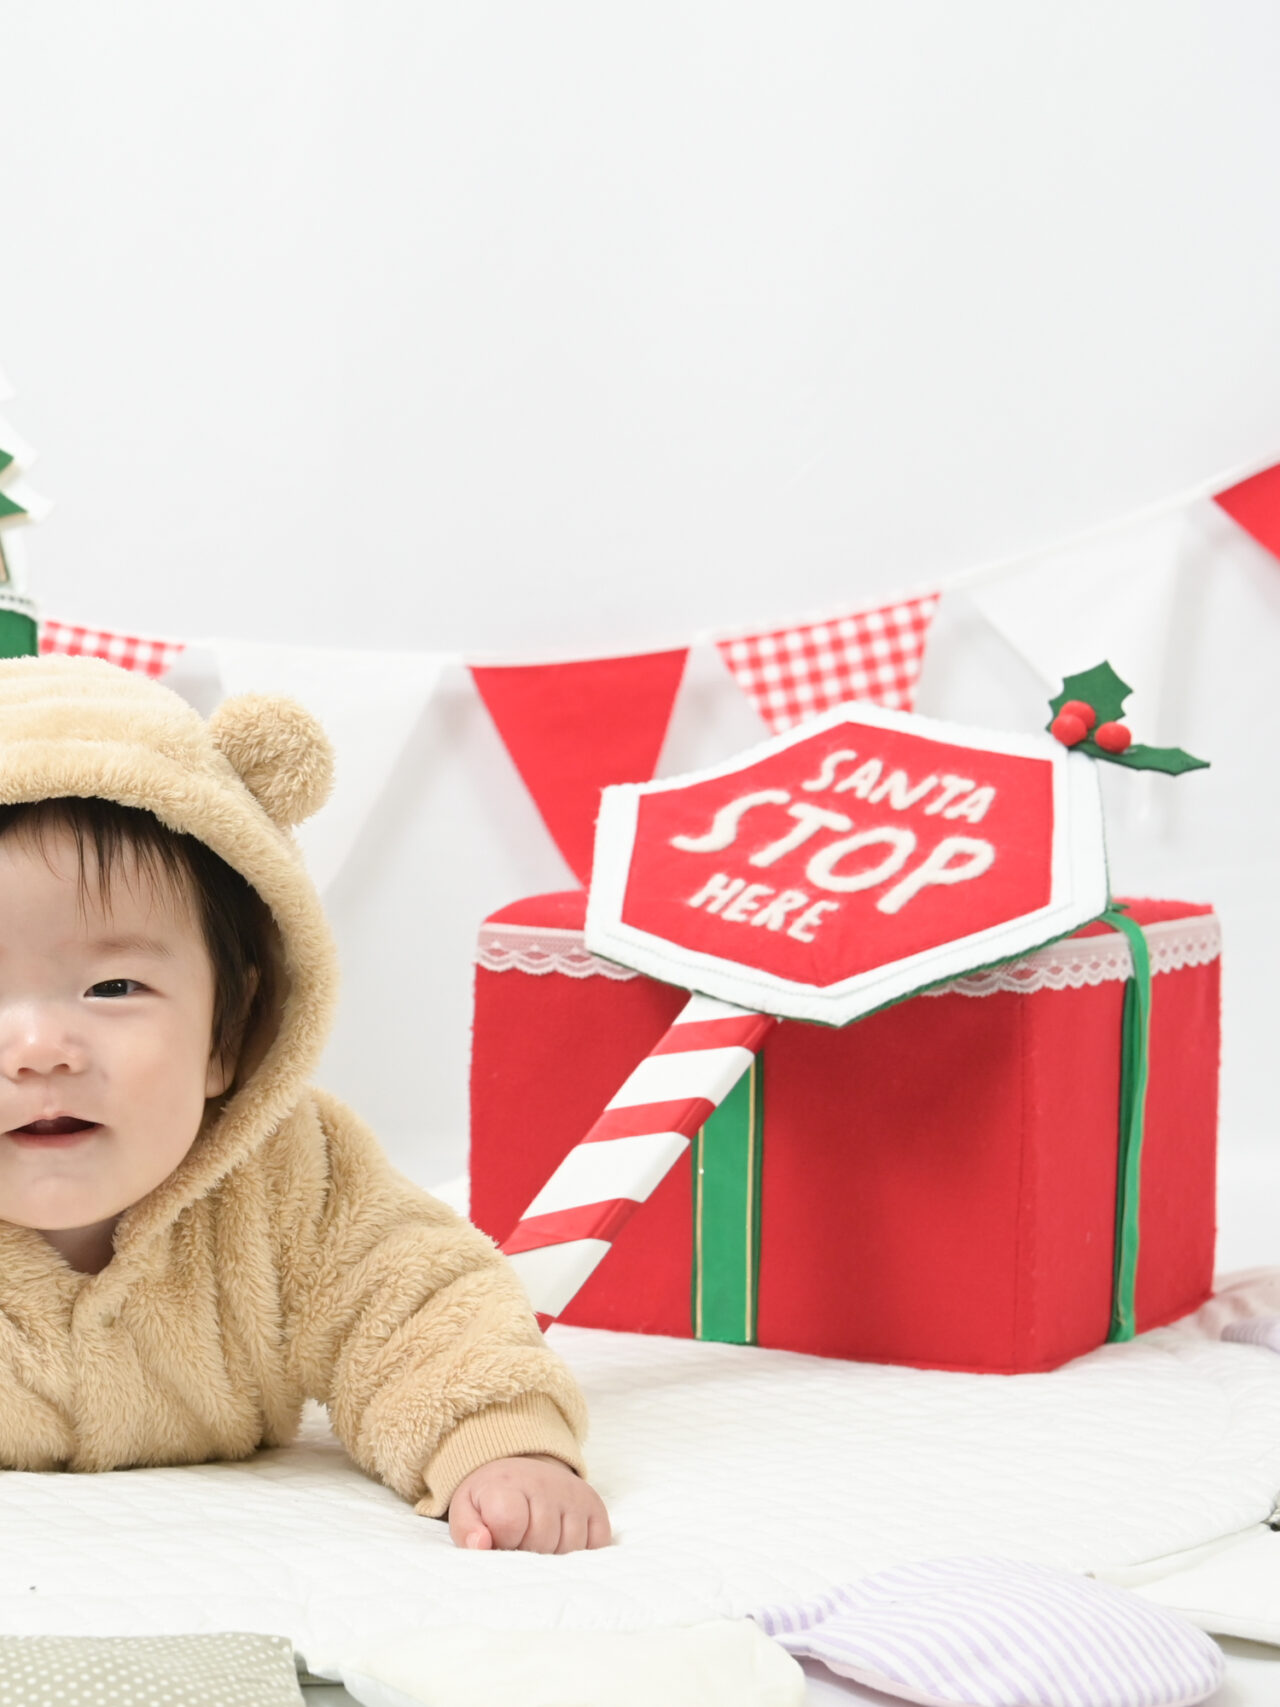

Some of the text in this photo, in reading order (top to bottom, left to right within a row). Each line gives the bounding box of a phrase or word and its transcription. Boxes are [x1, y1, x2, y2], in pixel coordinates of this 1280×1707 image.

[802, 750, 996, 823] SANTA
[669, 789, 996, 914] STOP
[686, 873, 839, 943] HERE
